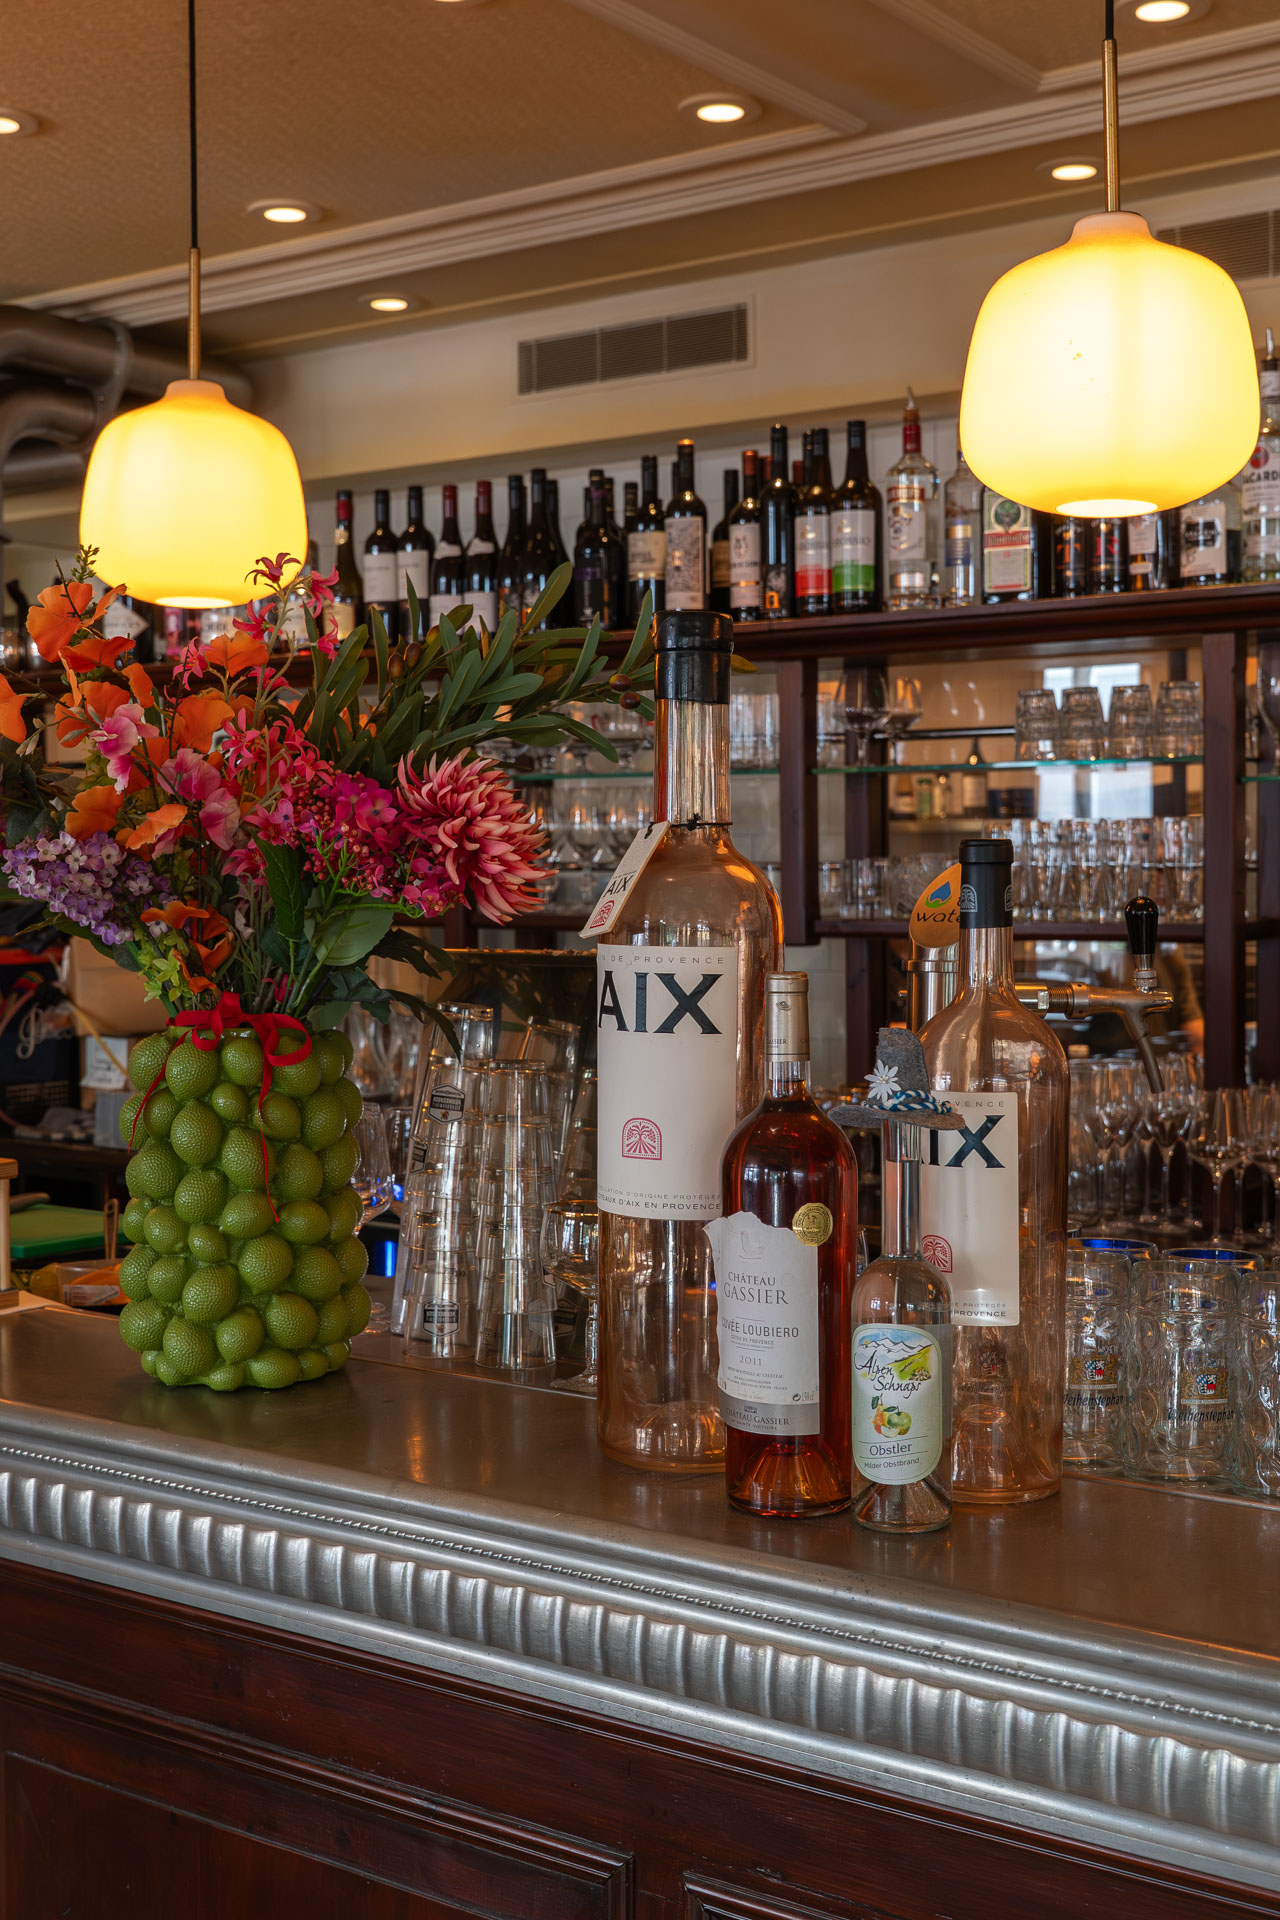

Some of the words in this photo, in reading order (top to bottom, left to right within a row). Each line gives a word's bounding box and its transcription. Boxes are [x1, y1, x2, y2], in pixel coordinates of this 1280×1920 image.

[602, 874, 634, 898] AIX
[634, 955, 724, 964] PROVENCE
[598, 970, 724, 1034] AIX
[921, 1114, 1006, 1168] IX
[618, 1198, 640, 1207] D'AIX
[728, 1271, 776, 1286] CHÂTEAU
[723, 1282, 789, 1305] GASSIER
[953, 1309, 1006, 1317] PROVENCE
[742, 1324, 799, 1338] LOUBIERO
[739, 1355, 762, 1366] 2011
[854, 1349, 894, 1381] Alpen
[873, 1375, 921, 1399] Schnaps
[753, 1416, 790, 1426] GASSIER
[1168, 1407, 1234, 1423] Weihenstephan
[869, 1443, 912, 1456] Obstler
[864, 1461, 882, 1469] Milder
[882, 1457, 920, 1469] Obstbrand
